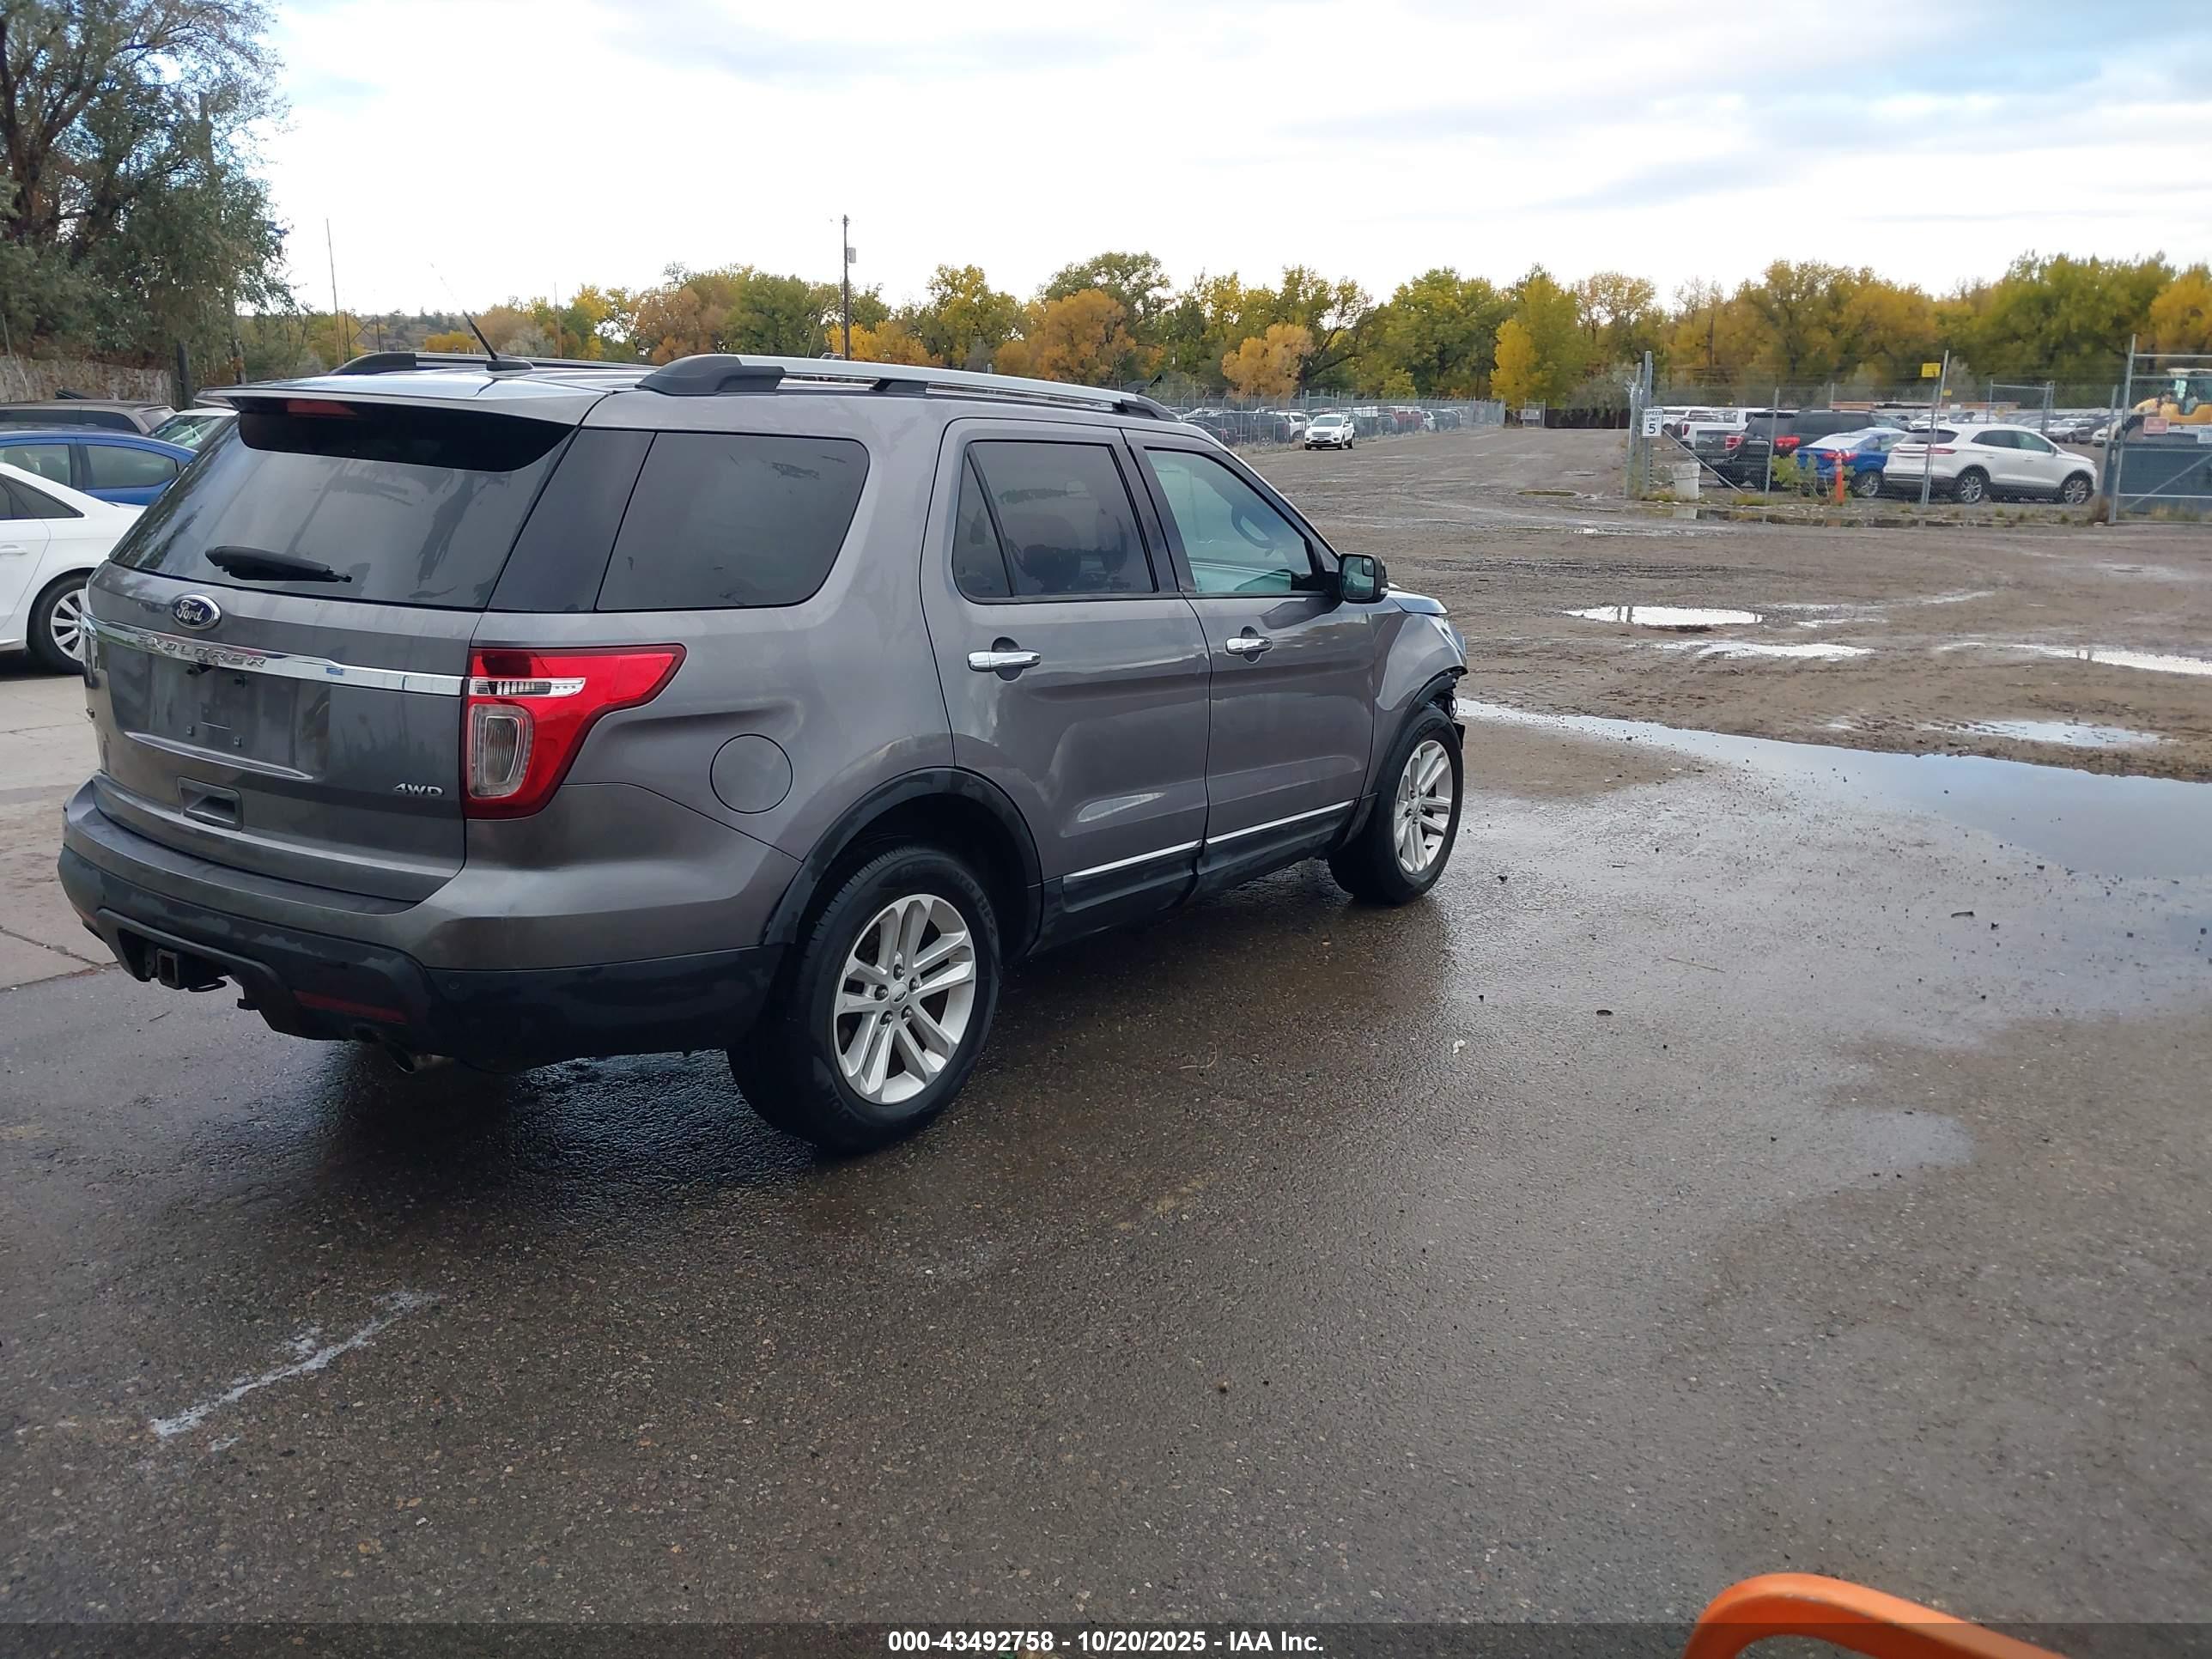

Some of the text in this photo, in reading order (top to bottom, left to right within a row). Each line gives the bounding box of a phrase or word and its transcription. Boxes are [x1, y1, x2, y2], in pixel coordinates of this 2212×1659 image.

[1649, 423, 1656, 434] 5
[176, 599, 204, 623] Ford
[137, 633, 268, 668] EXPLORER
[393, 782, 444, 797] 4WD
